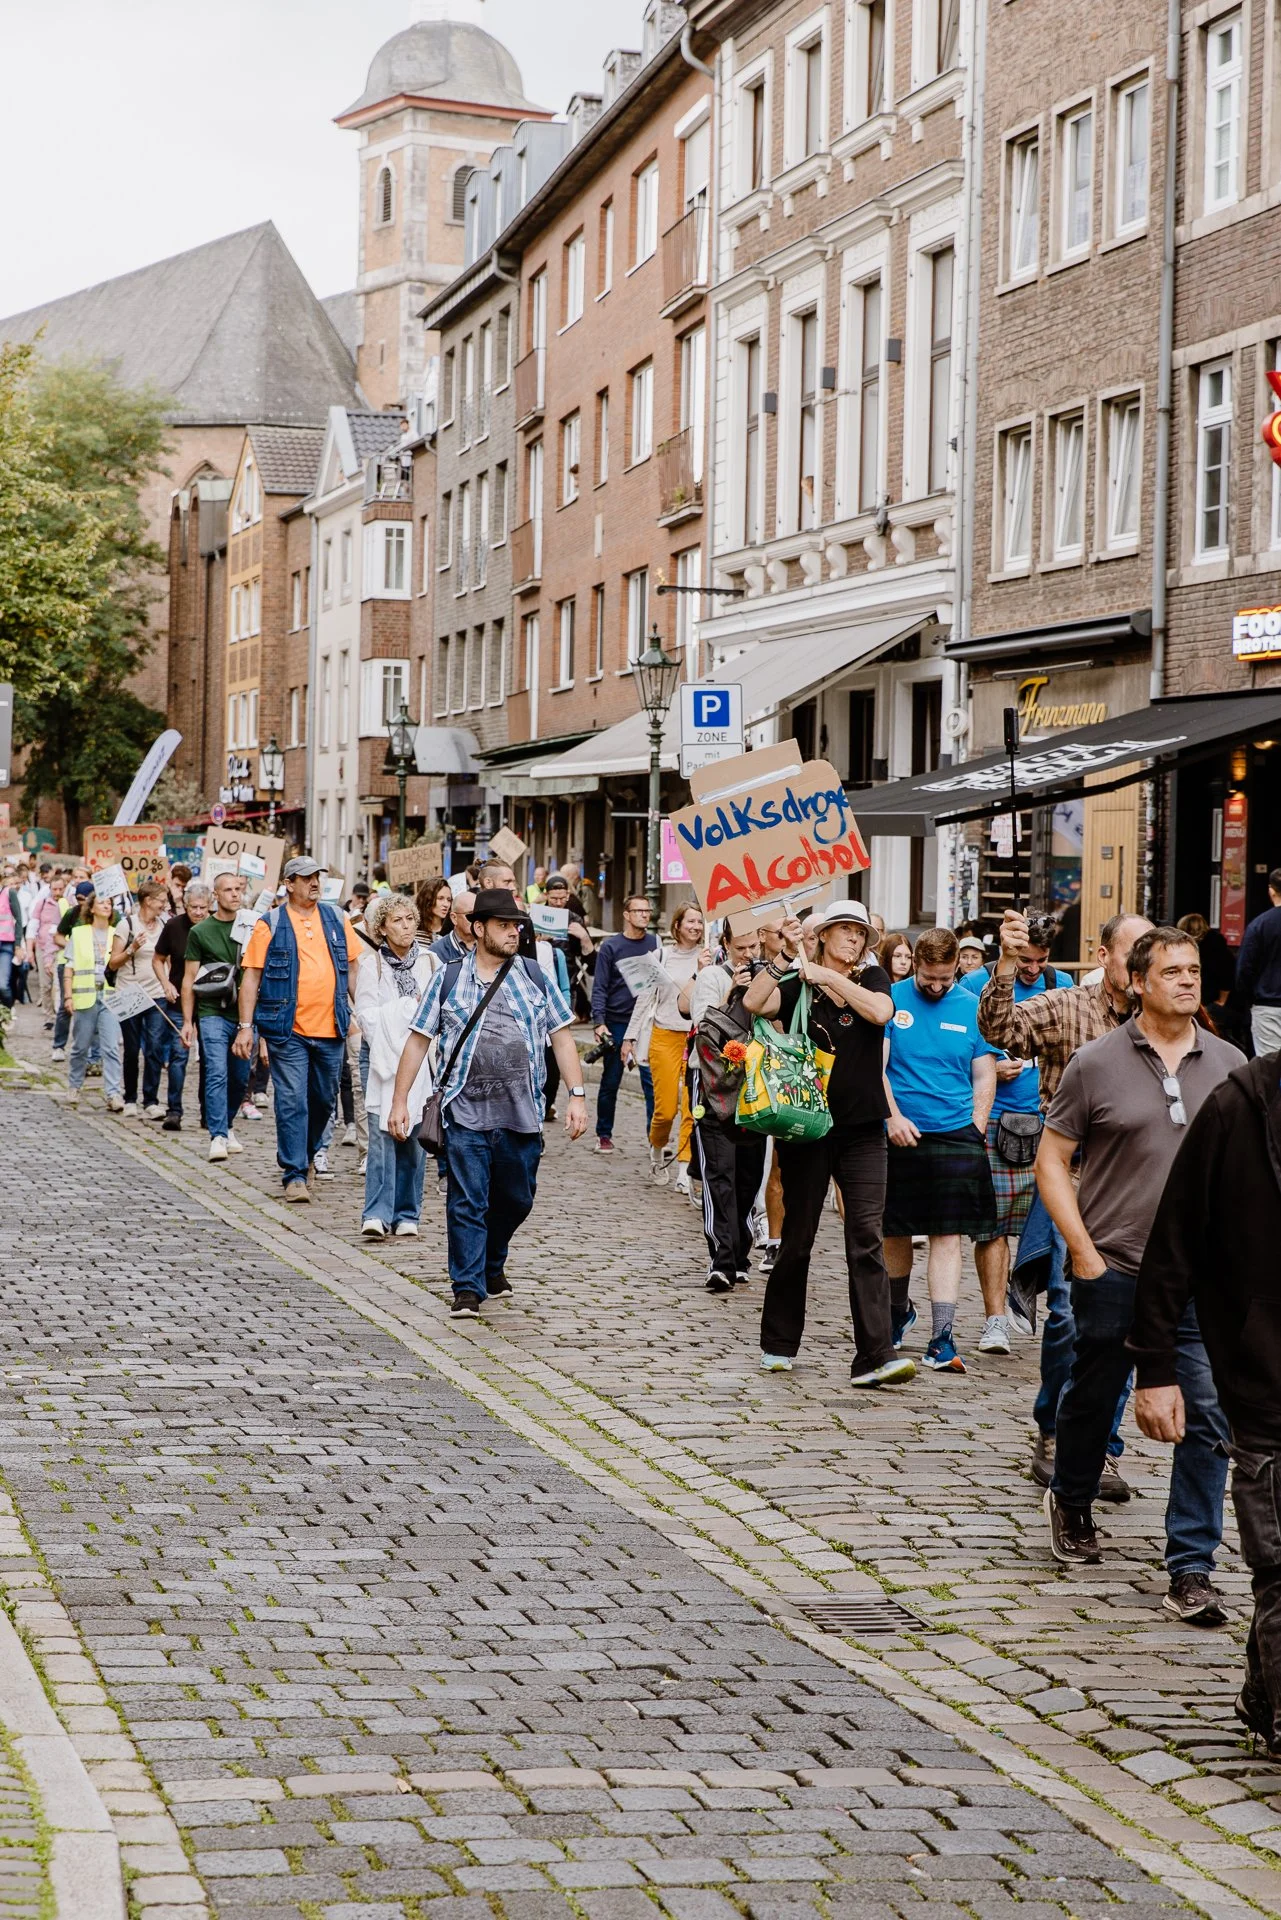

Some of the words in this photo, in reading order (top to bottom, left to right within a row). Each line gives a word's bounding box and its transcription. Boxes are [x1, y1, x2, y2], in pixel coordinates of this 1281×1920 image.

[1232, 612, 1281, 640] FOO
[701, 695, 722, 723] P
[1016, 676, 1107, 737] Franzmann
[697, 732, 728, 743] ZONE
[704, 751, 720, 759] mit
[92, 832, 109, 842] no
[115, 829, 158, 843] shame
